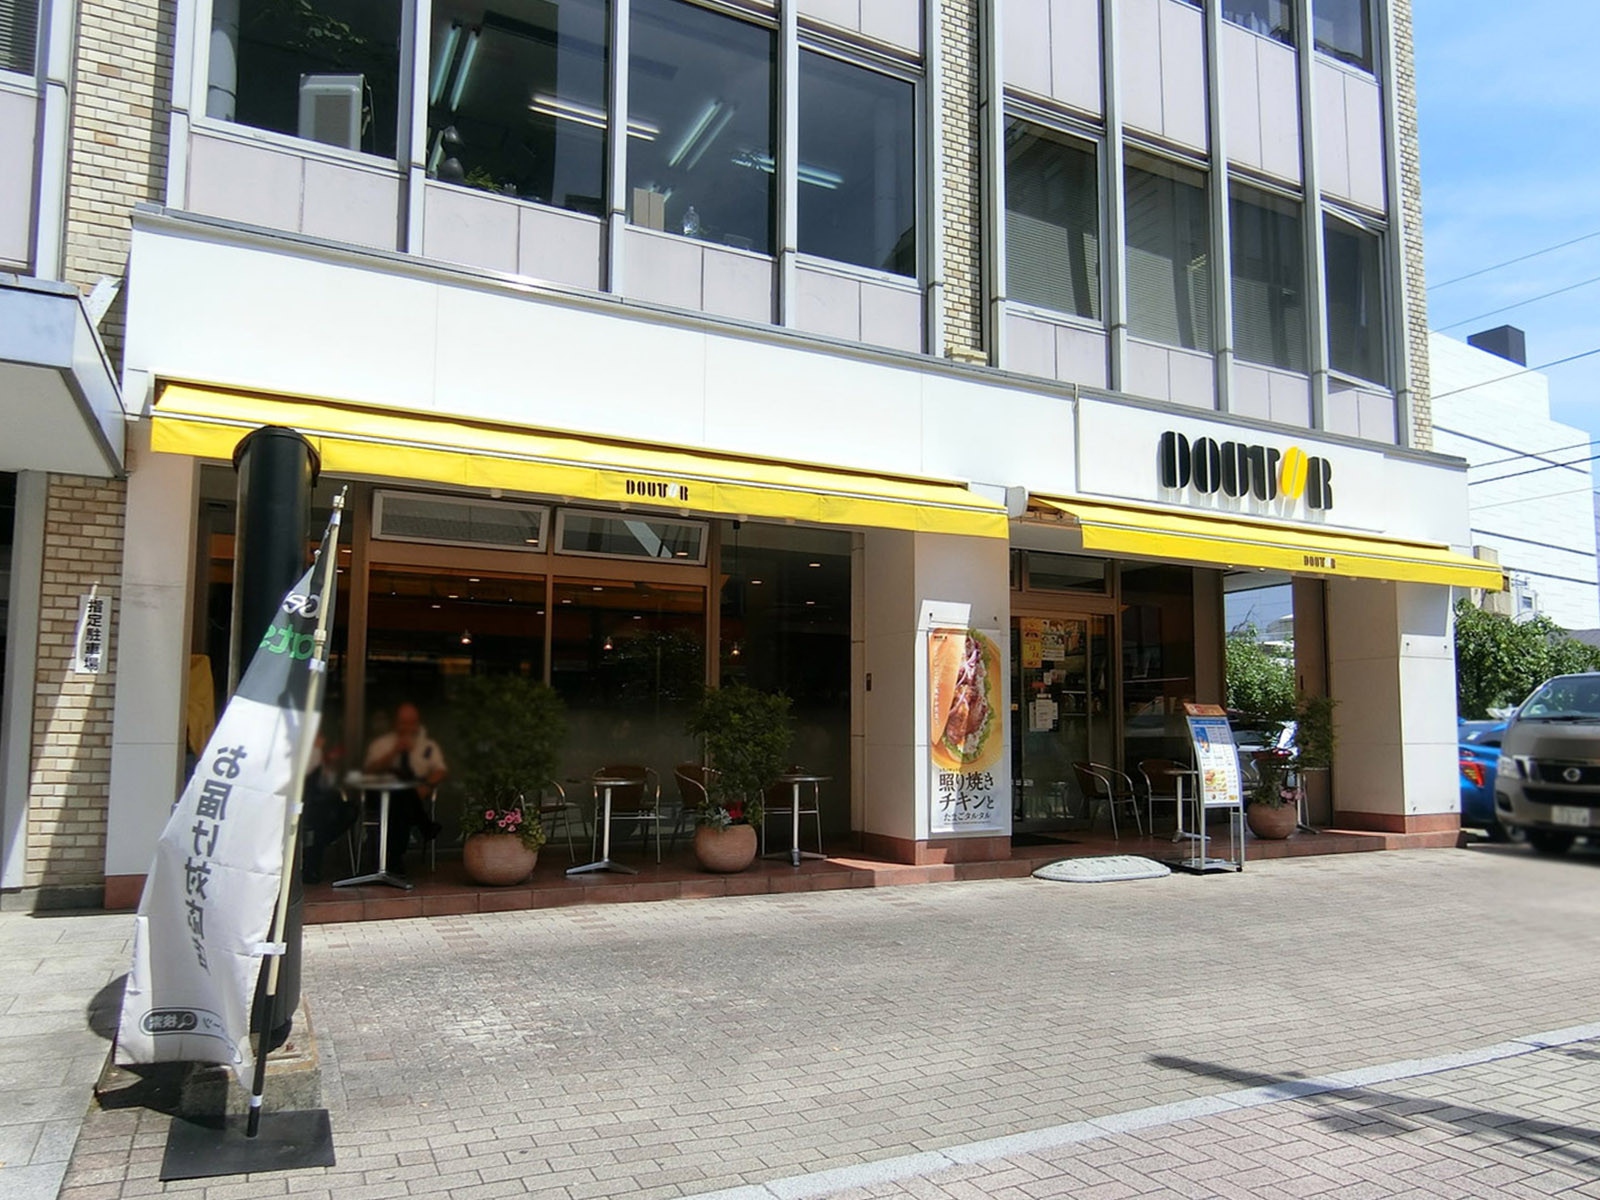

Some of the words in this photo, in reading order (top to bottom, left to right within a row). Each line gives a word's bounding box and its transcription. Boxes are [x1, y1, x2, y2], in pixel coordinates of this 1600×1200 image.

[1161, 430, 1333, 511] DOUTOR
[626, 479, 688, 501] DOUTOR
[84, 597, 103, 672] 指定駐車場
[938, 771, 994, 792] 照り焼き
[938, 791, 995, 812] チキンと
